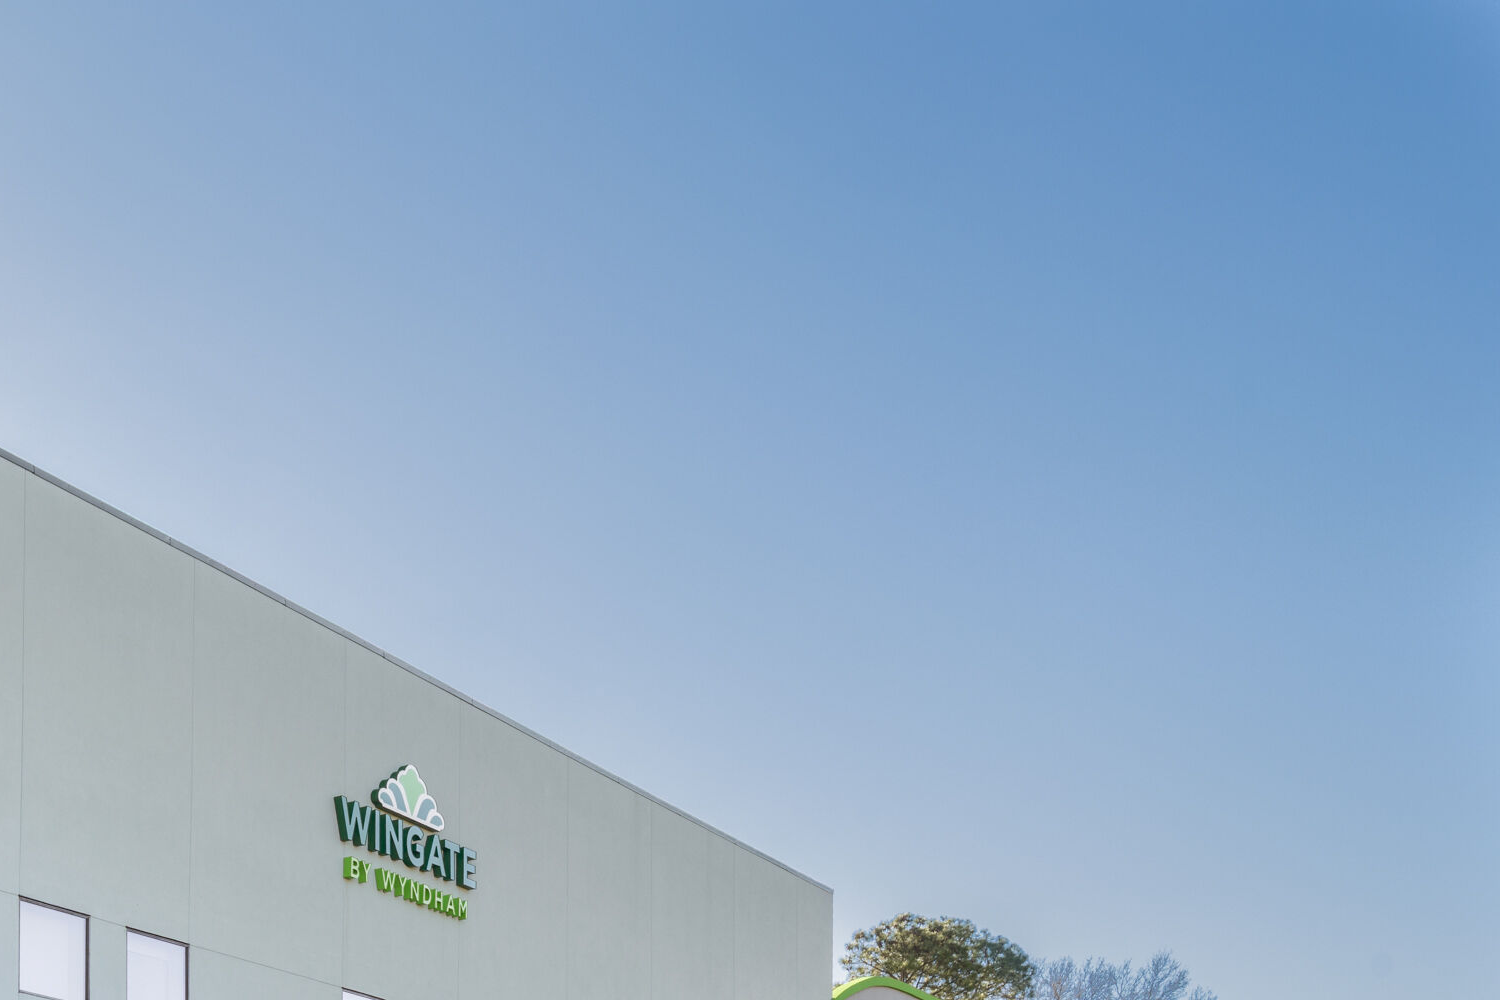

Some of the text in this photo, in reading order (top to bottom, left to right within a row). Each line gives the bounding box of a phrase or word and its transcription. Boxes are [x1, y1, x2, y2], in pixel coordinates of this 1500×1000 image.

[334, 795, 477, 890] WINGATE
[344, 856, 468, 920] BY WYNDHAM
